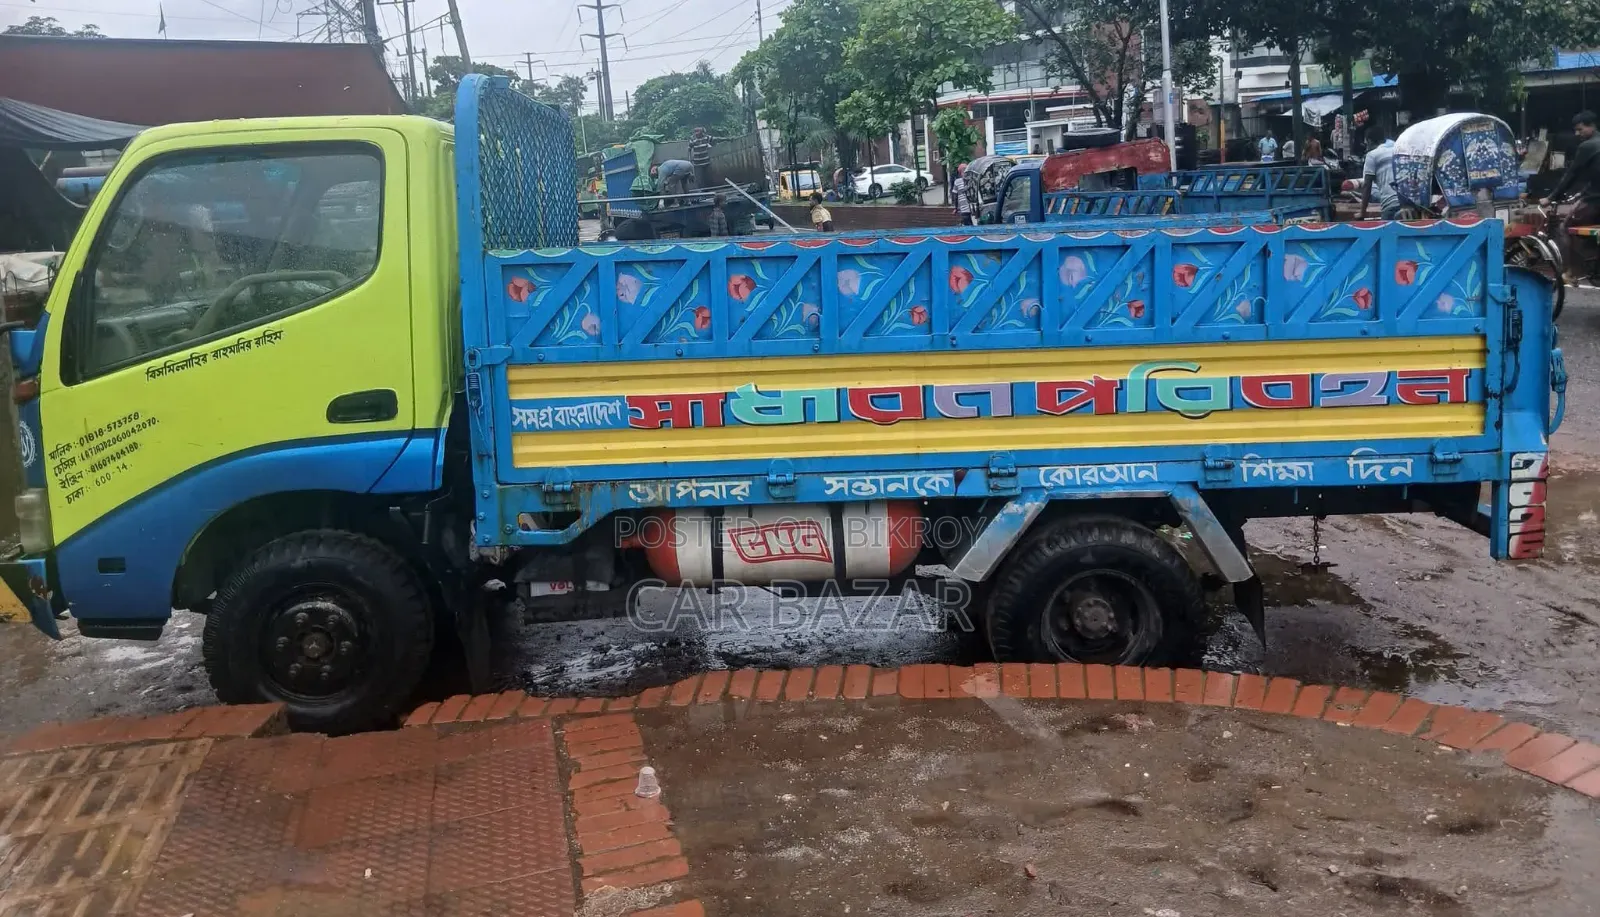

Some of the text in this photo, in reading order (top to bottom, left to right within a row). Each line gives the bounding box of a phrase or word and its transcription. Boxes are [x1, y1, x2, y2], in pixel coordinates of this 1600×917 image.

[511, 405, 553, 430] সমগ্র
[554, 399, 622, 428] বাংলাদেশ
[1035, 360, 1471, 417] পরিবহন
[628, 446, 1414, 503] আপনার সন্তানকে কোরআন শিক্ষা দিন
[738, 527, 822, 557] CNG
